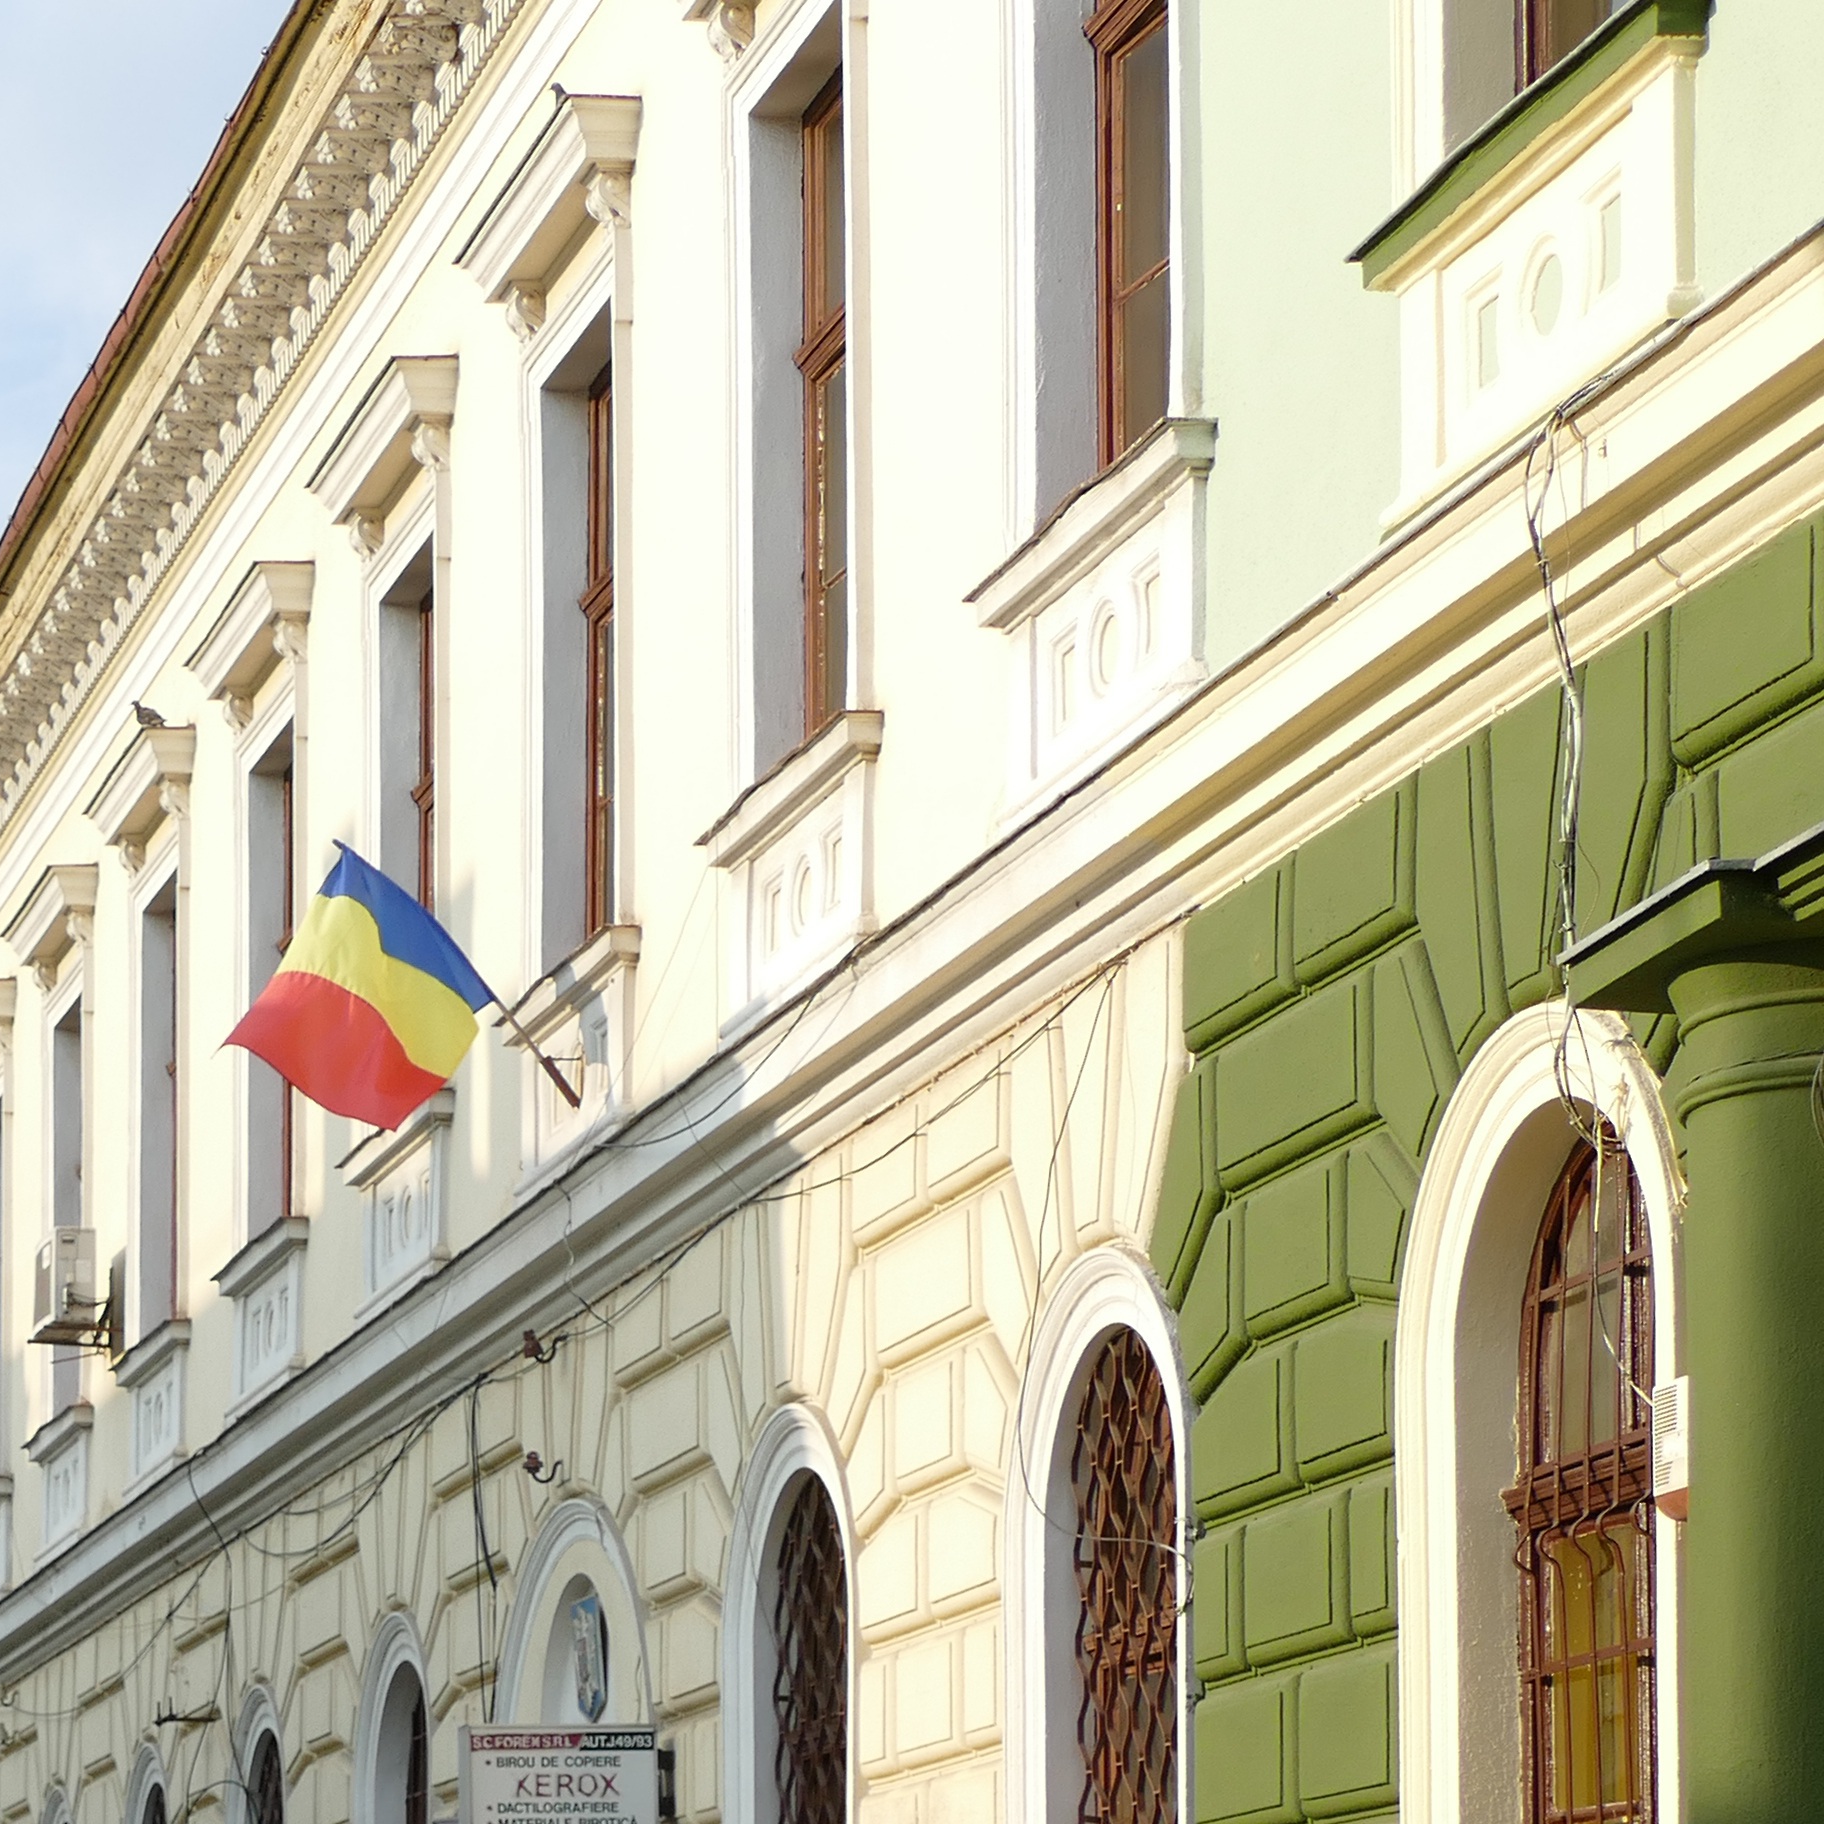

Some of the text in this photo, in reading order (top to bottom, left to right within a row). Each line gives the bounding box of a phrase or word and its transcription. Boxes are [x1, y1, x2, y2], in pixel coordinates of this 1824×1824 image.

[496, 1756, 621, 1768] BIROU DE COPIERE
[497, 1802, 620, 1814] DACTILOGRAFIERE
